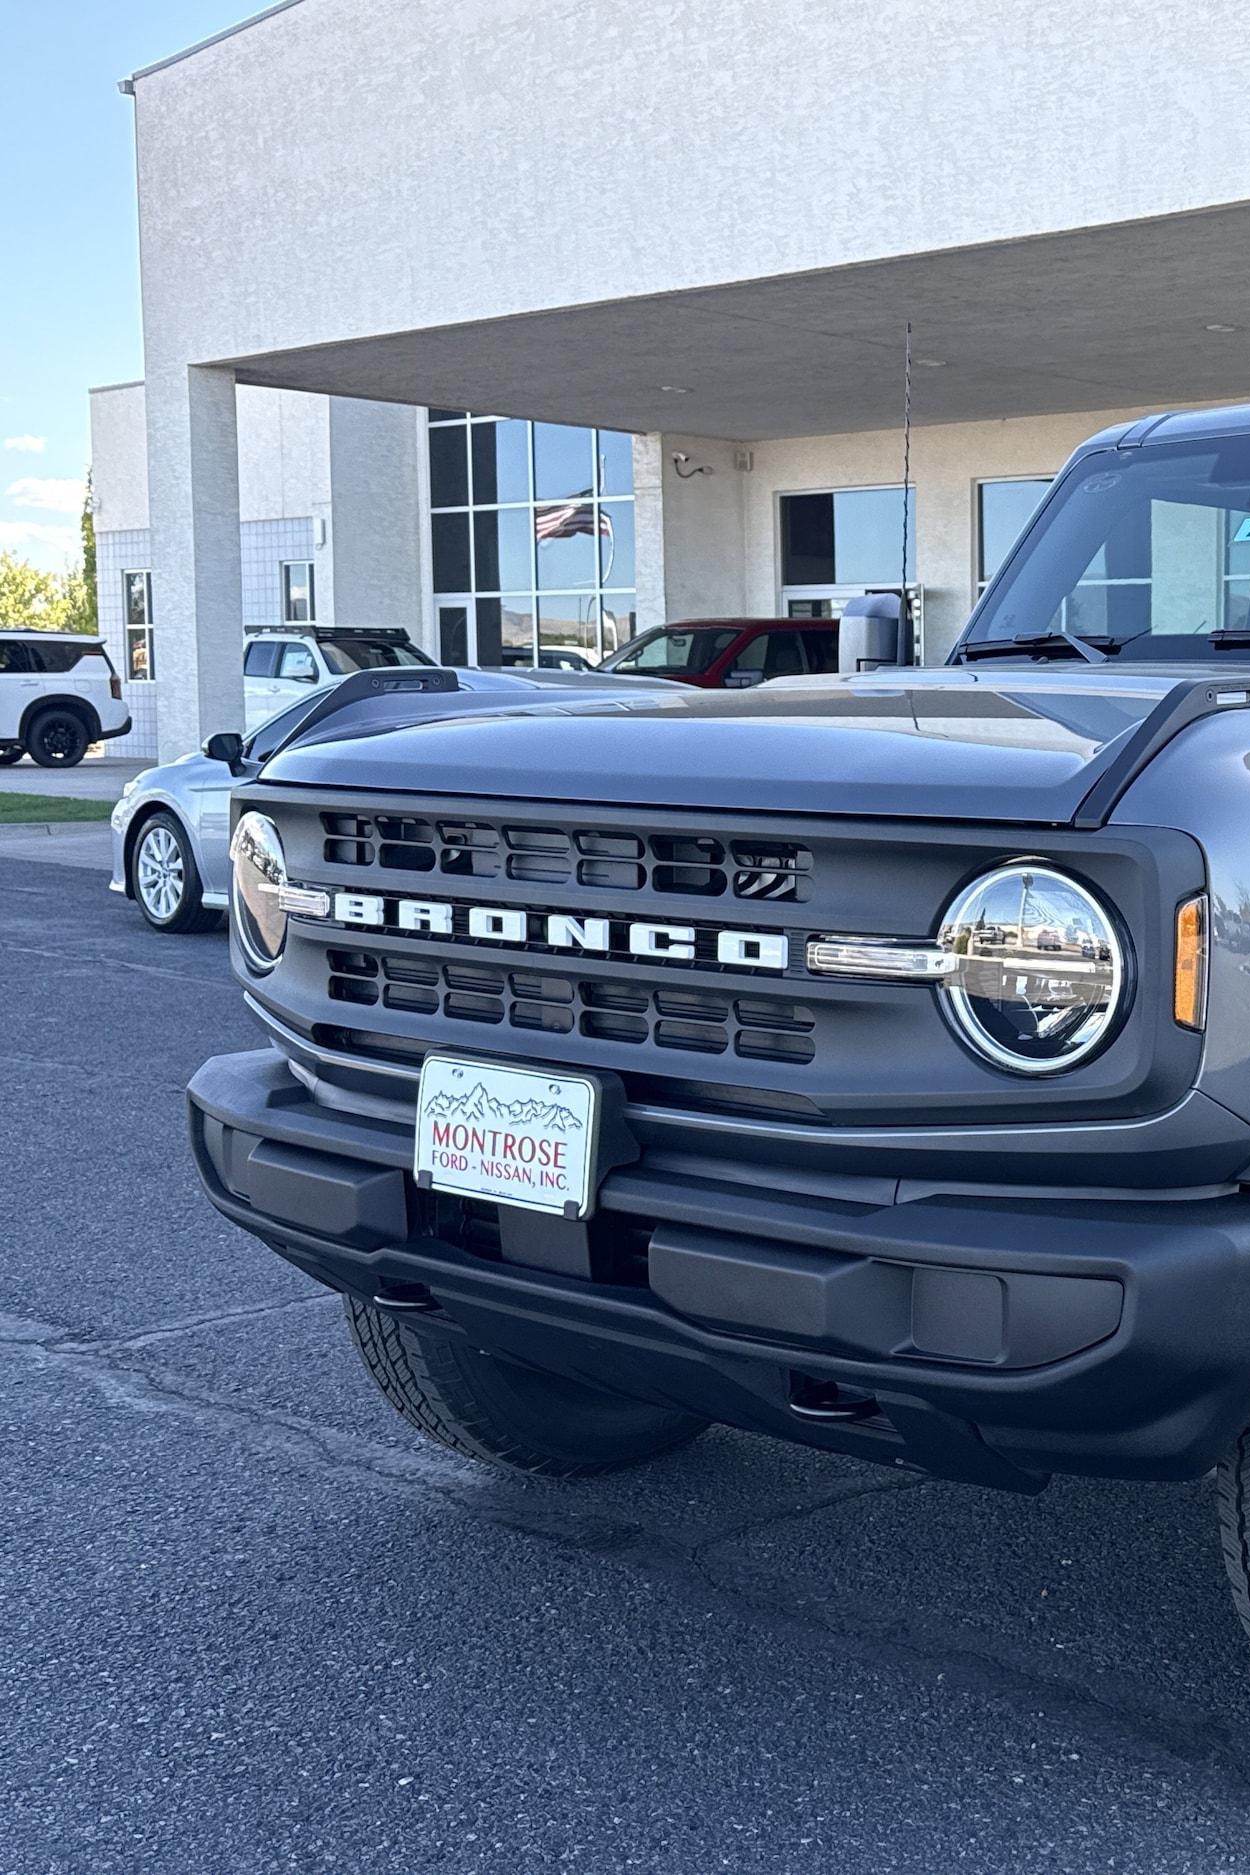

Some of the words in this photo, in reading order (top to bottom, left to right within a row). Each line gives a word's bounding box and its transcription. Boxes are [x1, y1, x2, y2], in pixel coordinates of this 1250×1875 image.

[334, 892, 789, 970] BRONCO
[432, 1120, 568, 1170] MONTROSE
[431, 1150, 468, 1172] FORD
[480, 1159, 537, 1188] NISSAN,
[540, 1170, 570, 1192] INC.
